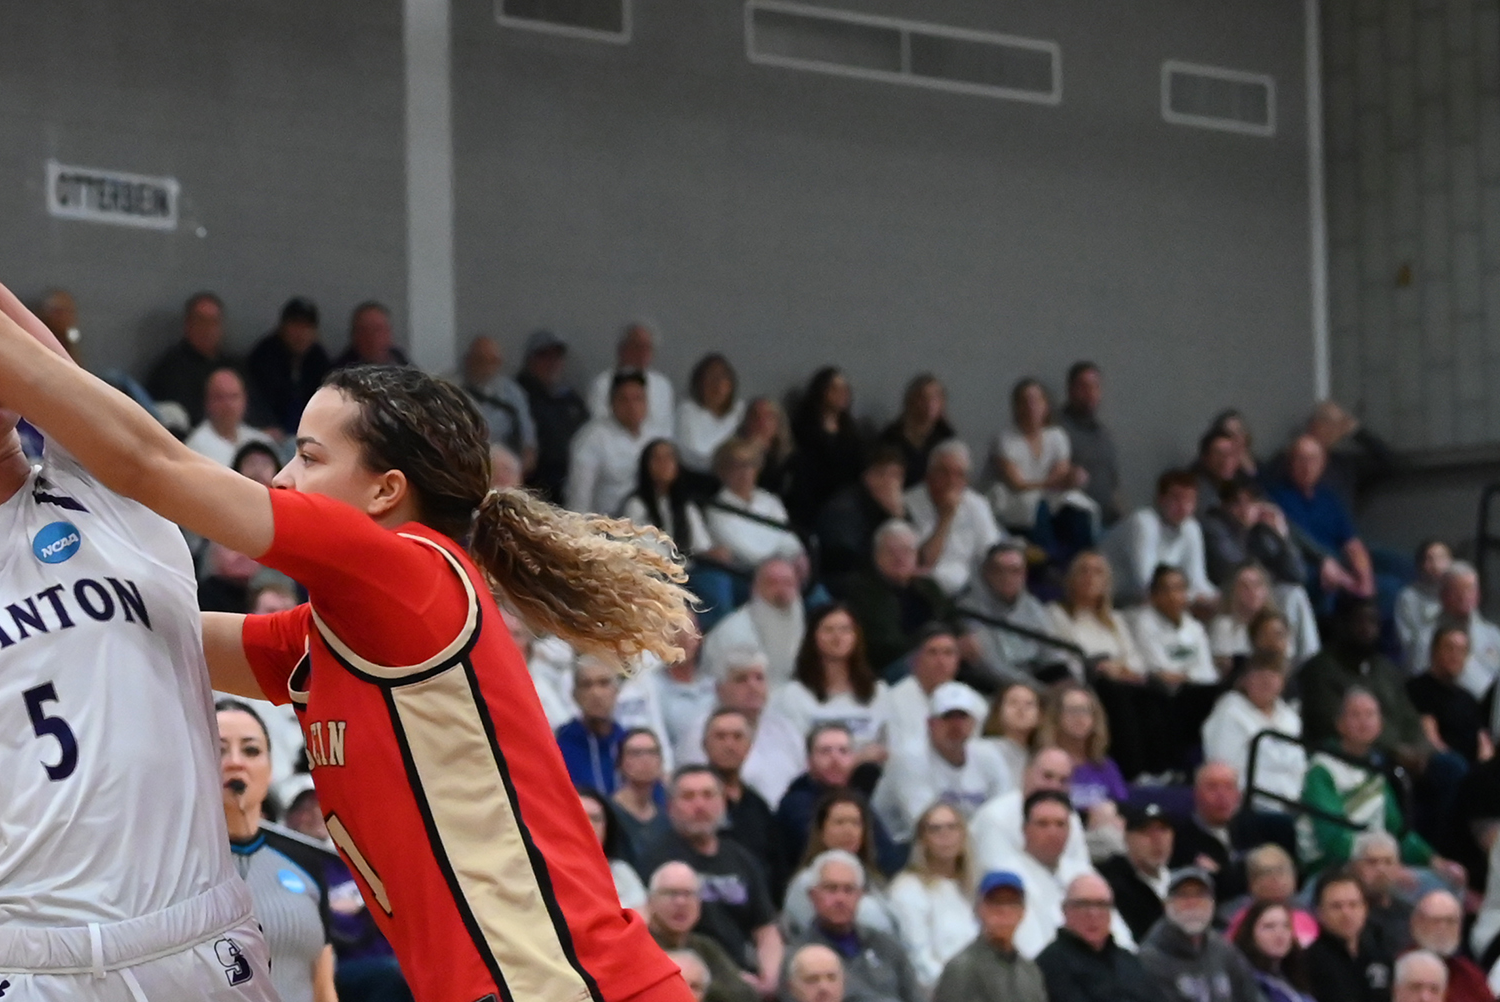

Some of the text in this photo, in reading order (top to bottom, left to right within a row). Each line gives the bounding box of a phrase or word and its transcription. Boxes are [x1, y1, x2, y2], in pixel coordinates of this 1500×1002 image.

[56, 172, 170, 218] OTTERBEIN
[40, 531, 80, 559] NCAA
[22, 680, 79, 782] 5
